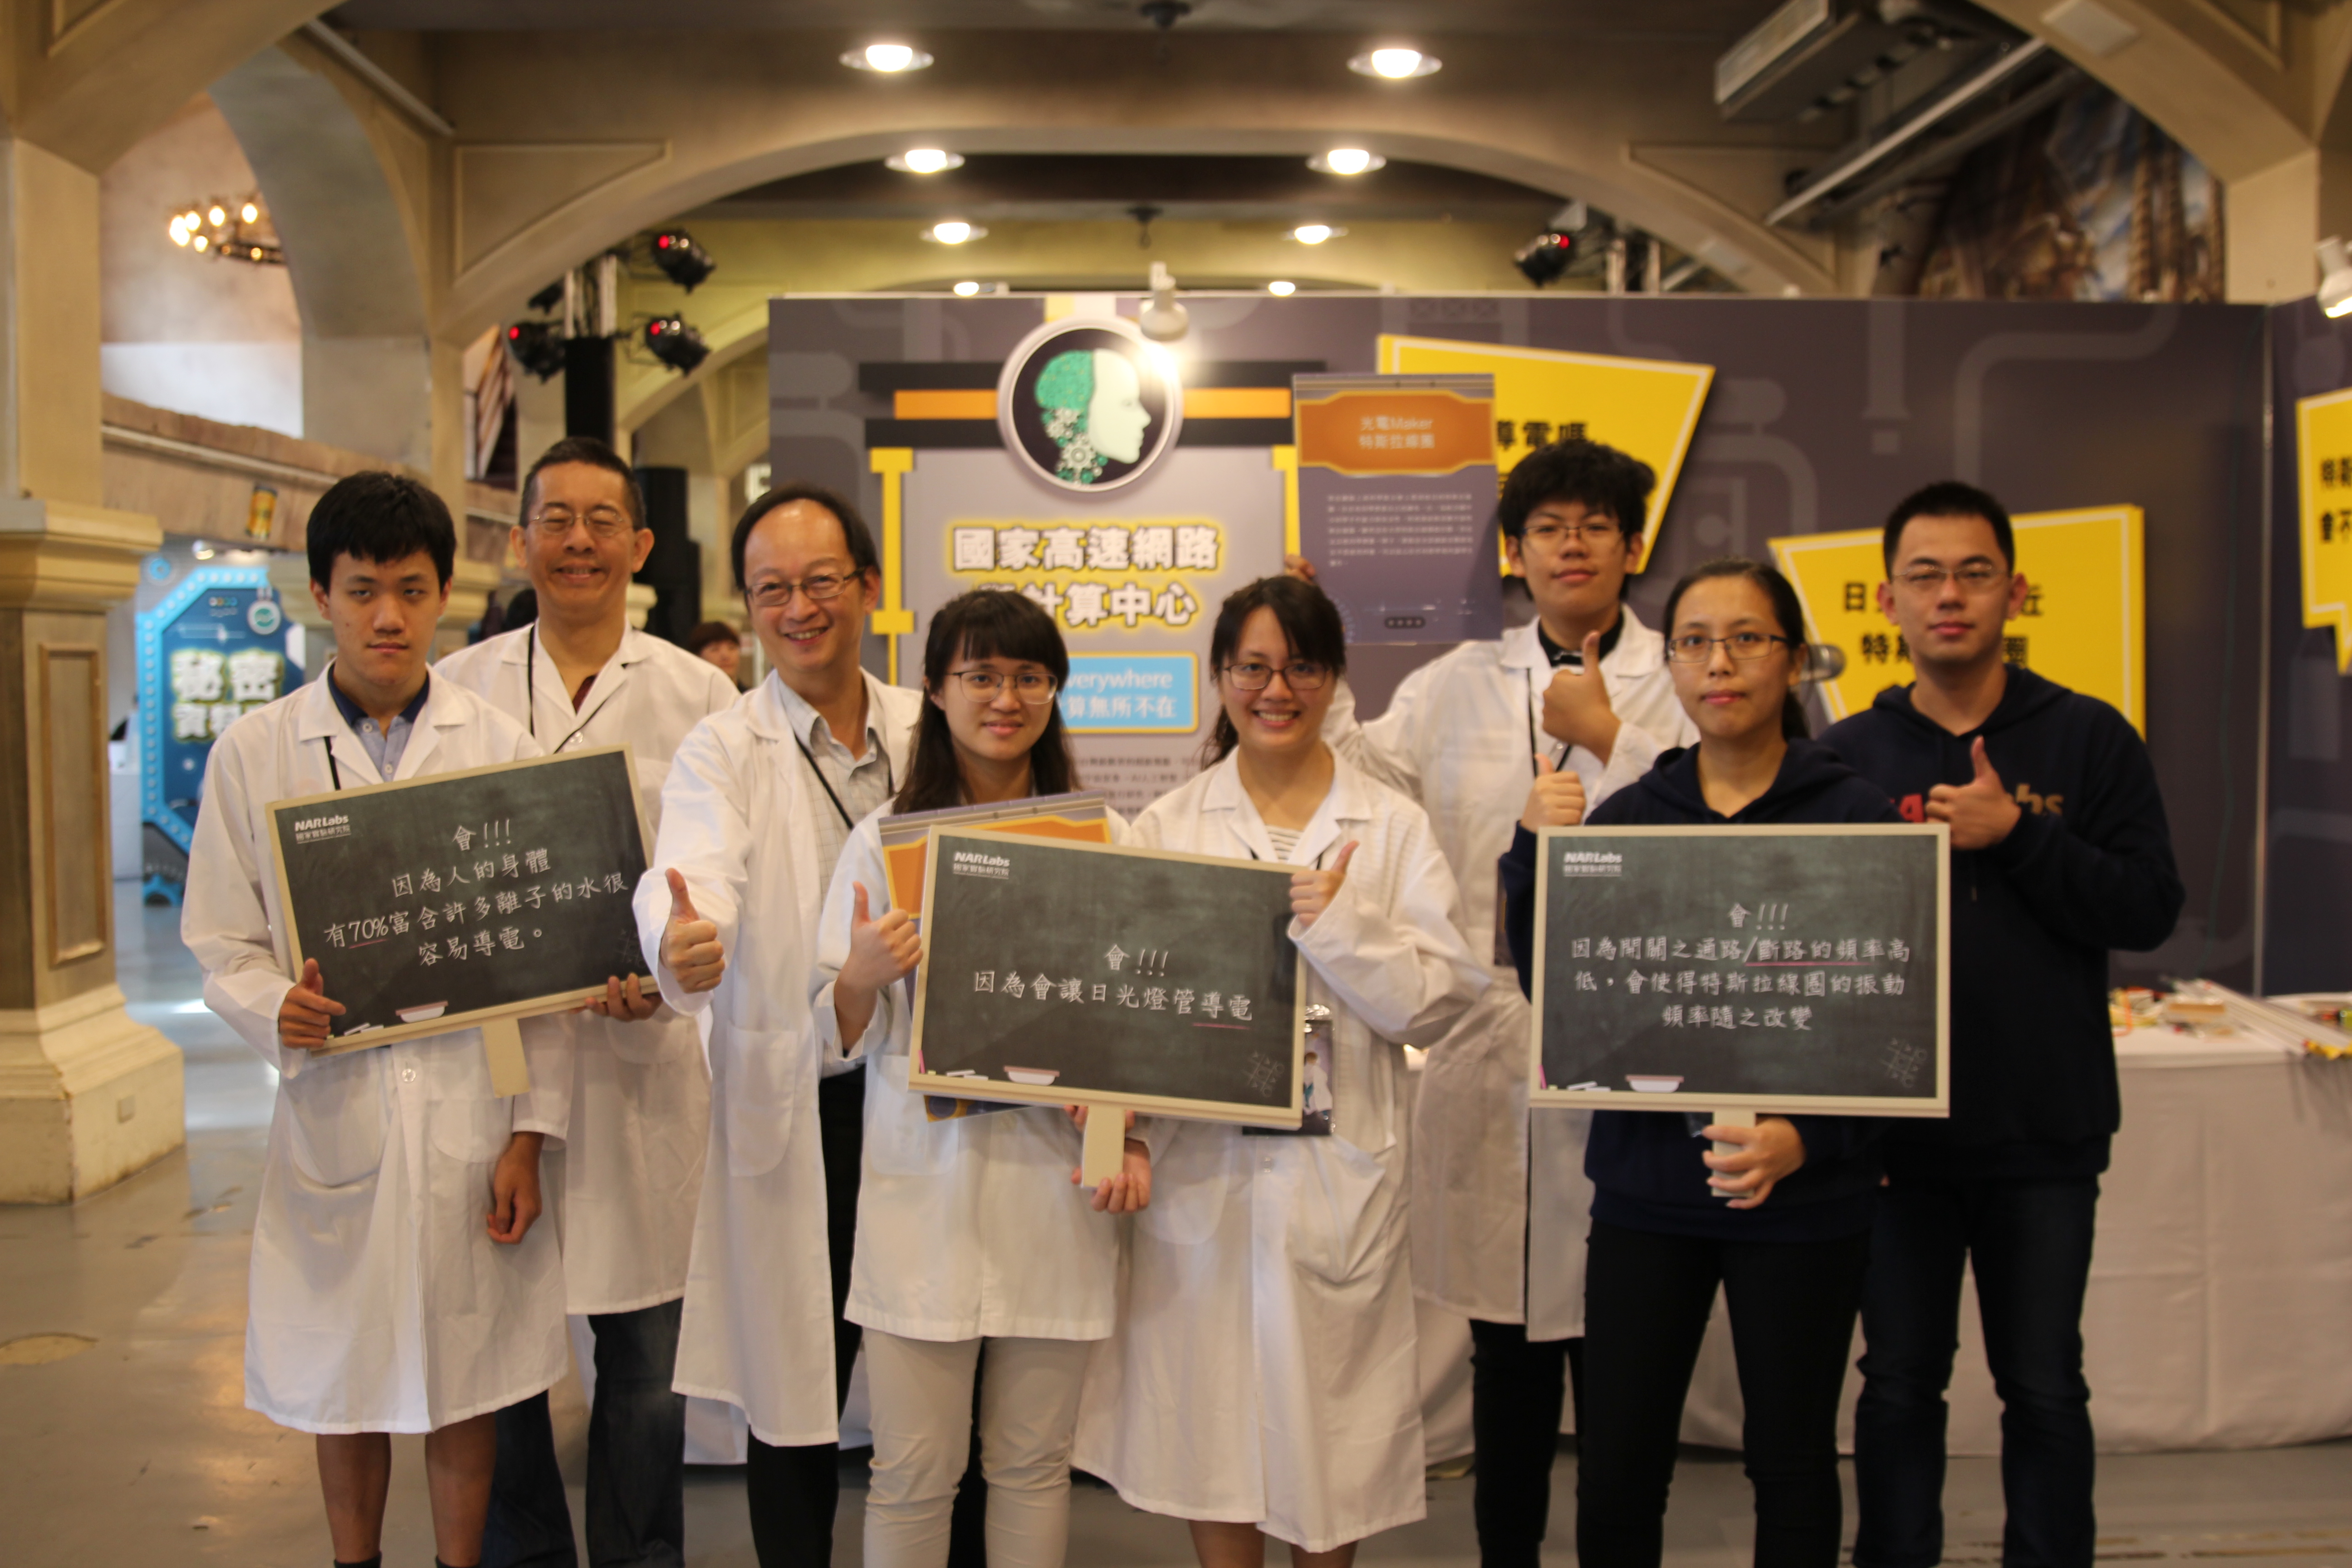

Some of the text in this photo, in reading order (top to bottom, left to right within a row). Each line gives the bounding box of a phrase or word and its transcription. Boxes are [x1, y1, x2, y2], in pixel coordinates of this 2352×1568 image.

[953, 525, 1219, 571] 國家高速網路
[978, 583, 1197, 627] 計算中心
[295, 815, 349, 832] NARLabs
[392, 848, 551, 897] 因為人的身體
[954, 851, 1011, 867] NARLabs
[323, 872, 629, 948] 有70%富含許多離子的水很
[418, 925, 542, 966] 容易導電。
[974, 970, 1253, 1021] 因為會讓日光燈管導電
[1661, 1004, 1812, 1030] 頻率隨之改變
